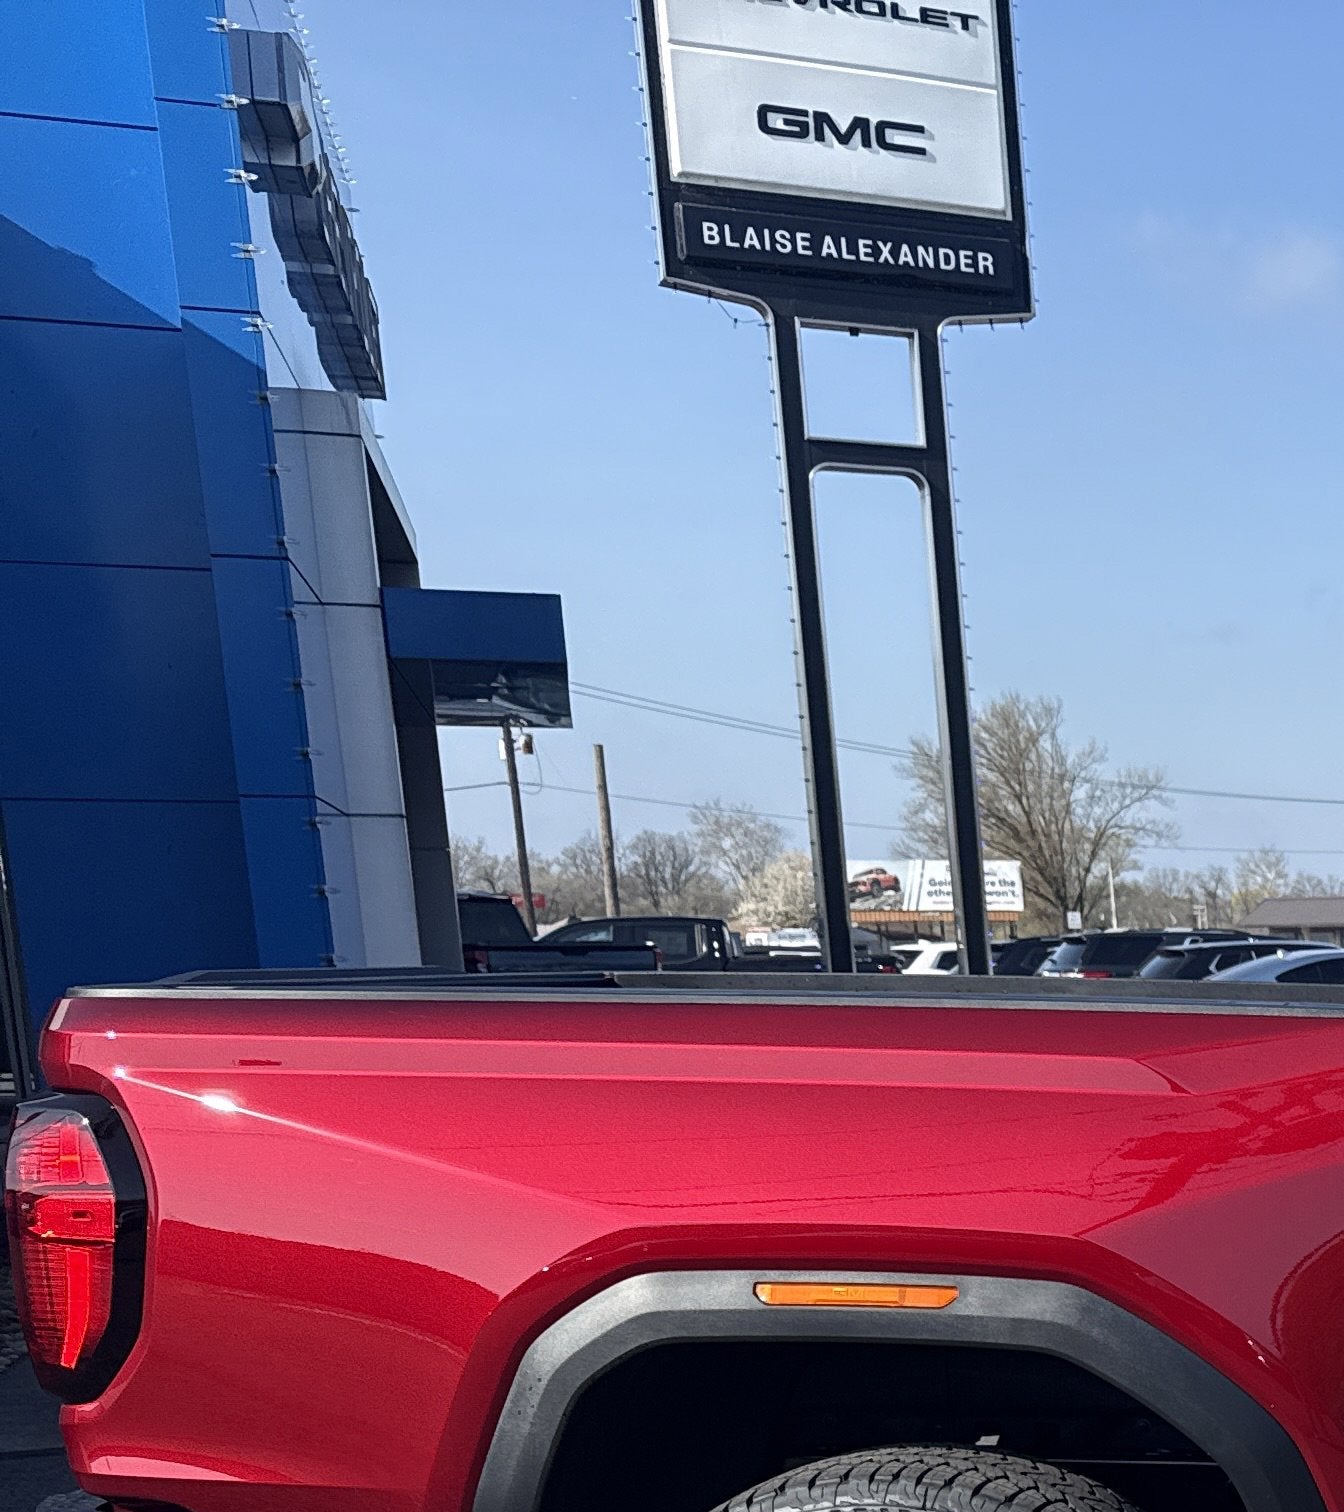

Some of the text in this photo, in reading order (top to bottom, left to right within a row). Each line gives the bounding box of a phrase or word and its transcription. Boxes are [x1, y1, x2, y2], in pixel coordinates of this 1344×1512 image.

[757, 103, 927, 156] GMC
[702, 221, 995, 276] BLAISE ALEXANDER
